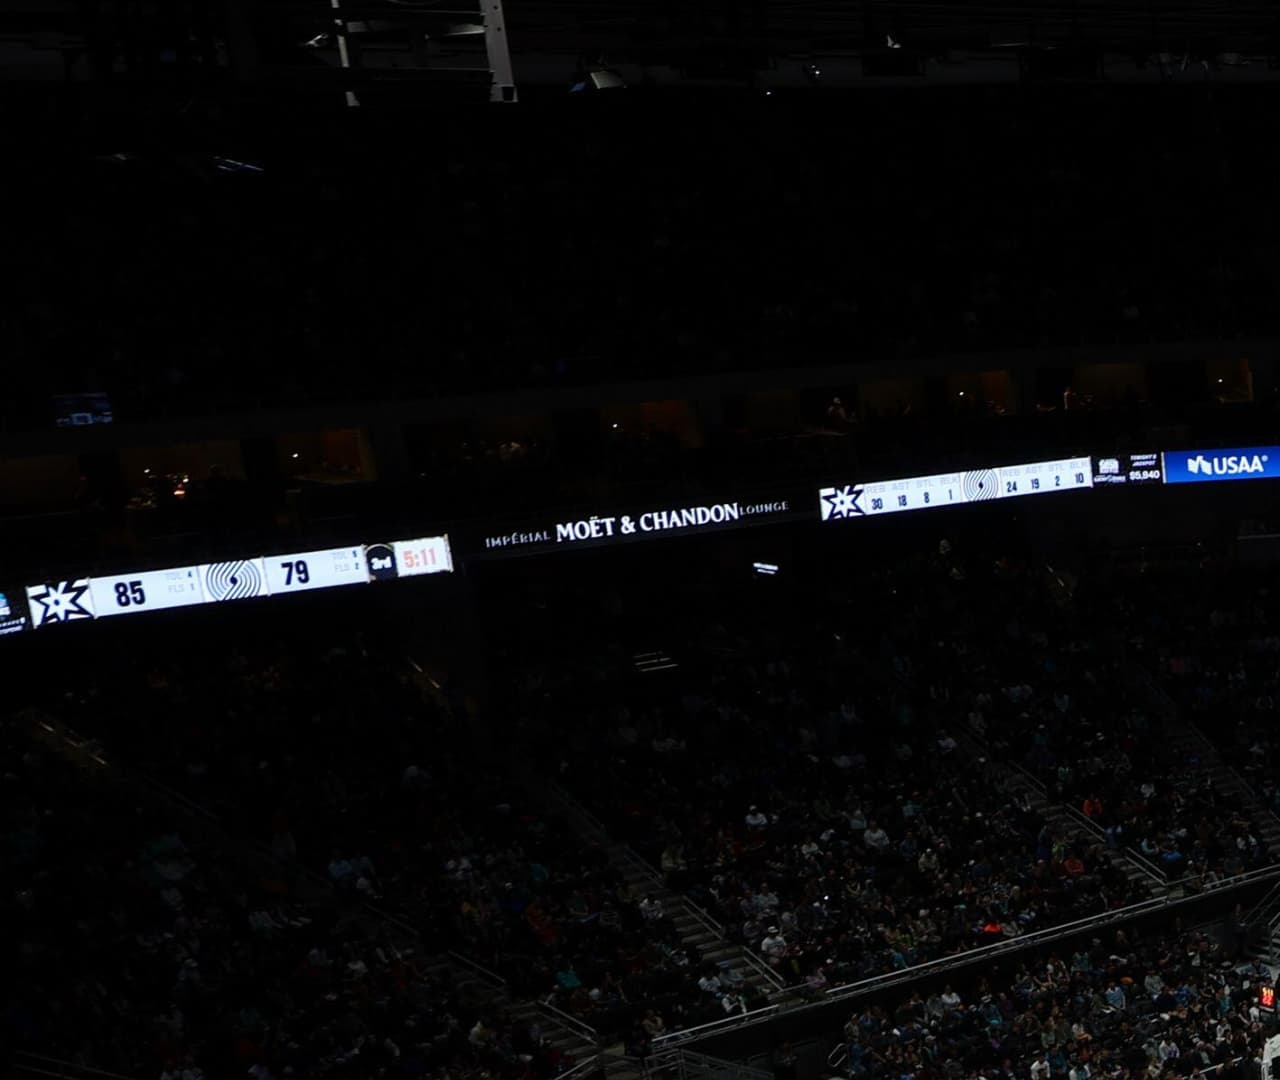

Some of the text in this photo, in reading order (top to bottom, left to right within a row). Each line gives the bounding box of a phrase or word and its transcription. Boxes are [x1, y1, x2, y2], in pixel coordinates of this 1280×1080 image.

[1213, 458, 1264, 475] USAA
[556, 516, 615, 542] MOËT
[621, 516, 636, 535] &
[640, 502, 739, 531] CHANDON
[739, 501, 789, 516] LOUNGE
[404, 548, 436, 568] 5:11
[281, 560, 309, 585] 79
[114, 580, 146, 607] 85
